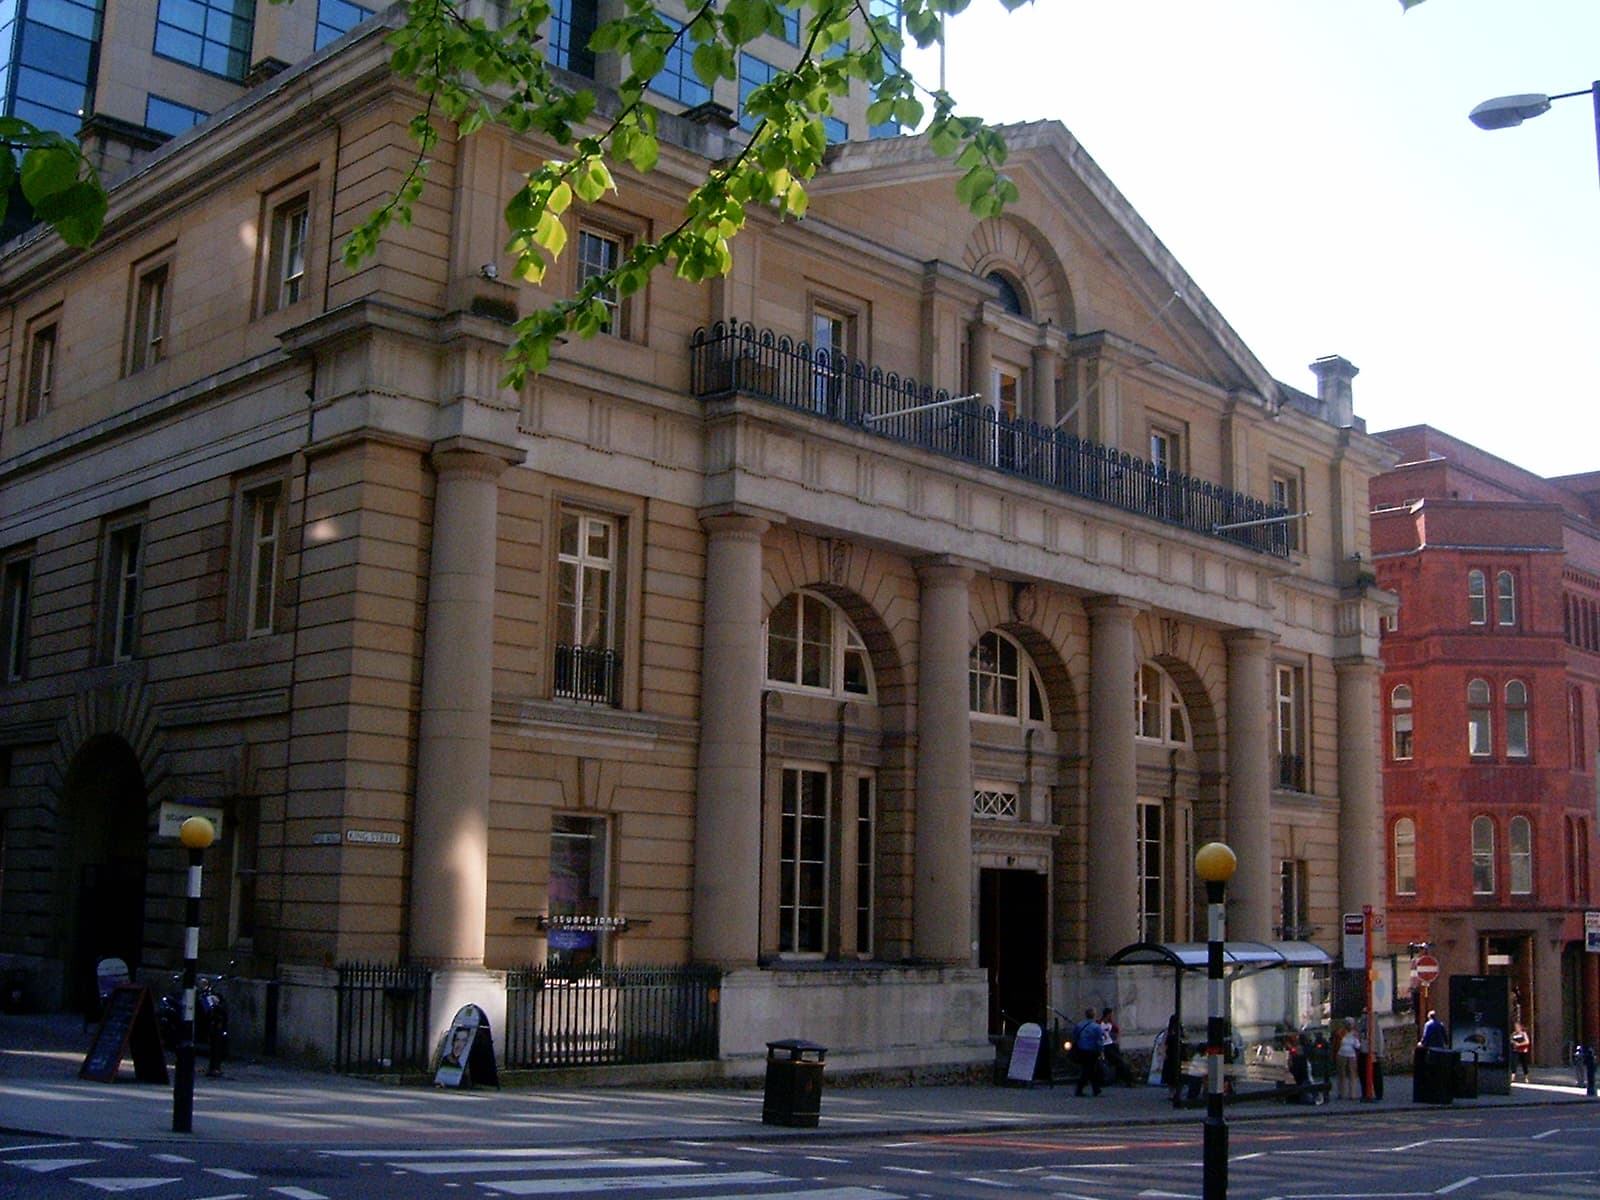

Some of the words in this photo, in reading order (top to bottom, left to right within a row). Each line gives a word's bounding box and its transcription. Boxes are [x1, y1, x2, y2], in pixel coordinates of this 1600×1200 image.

[348, 831, 369, 841] KING
[371, 833, 400, 843] STREET
[552, 915, 591, 924] stuart
[594, 916, 626, 925] jones
